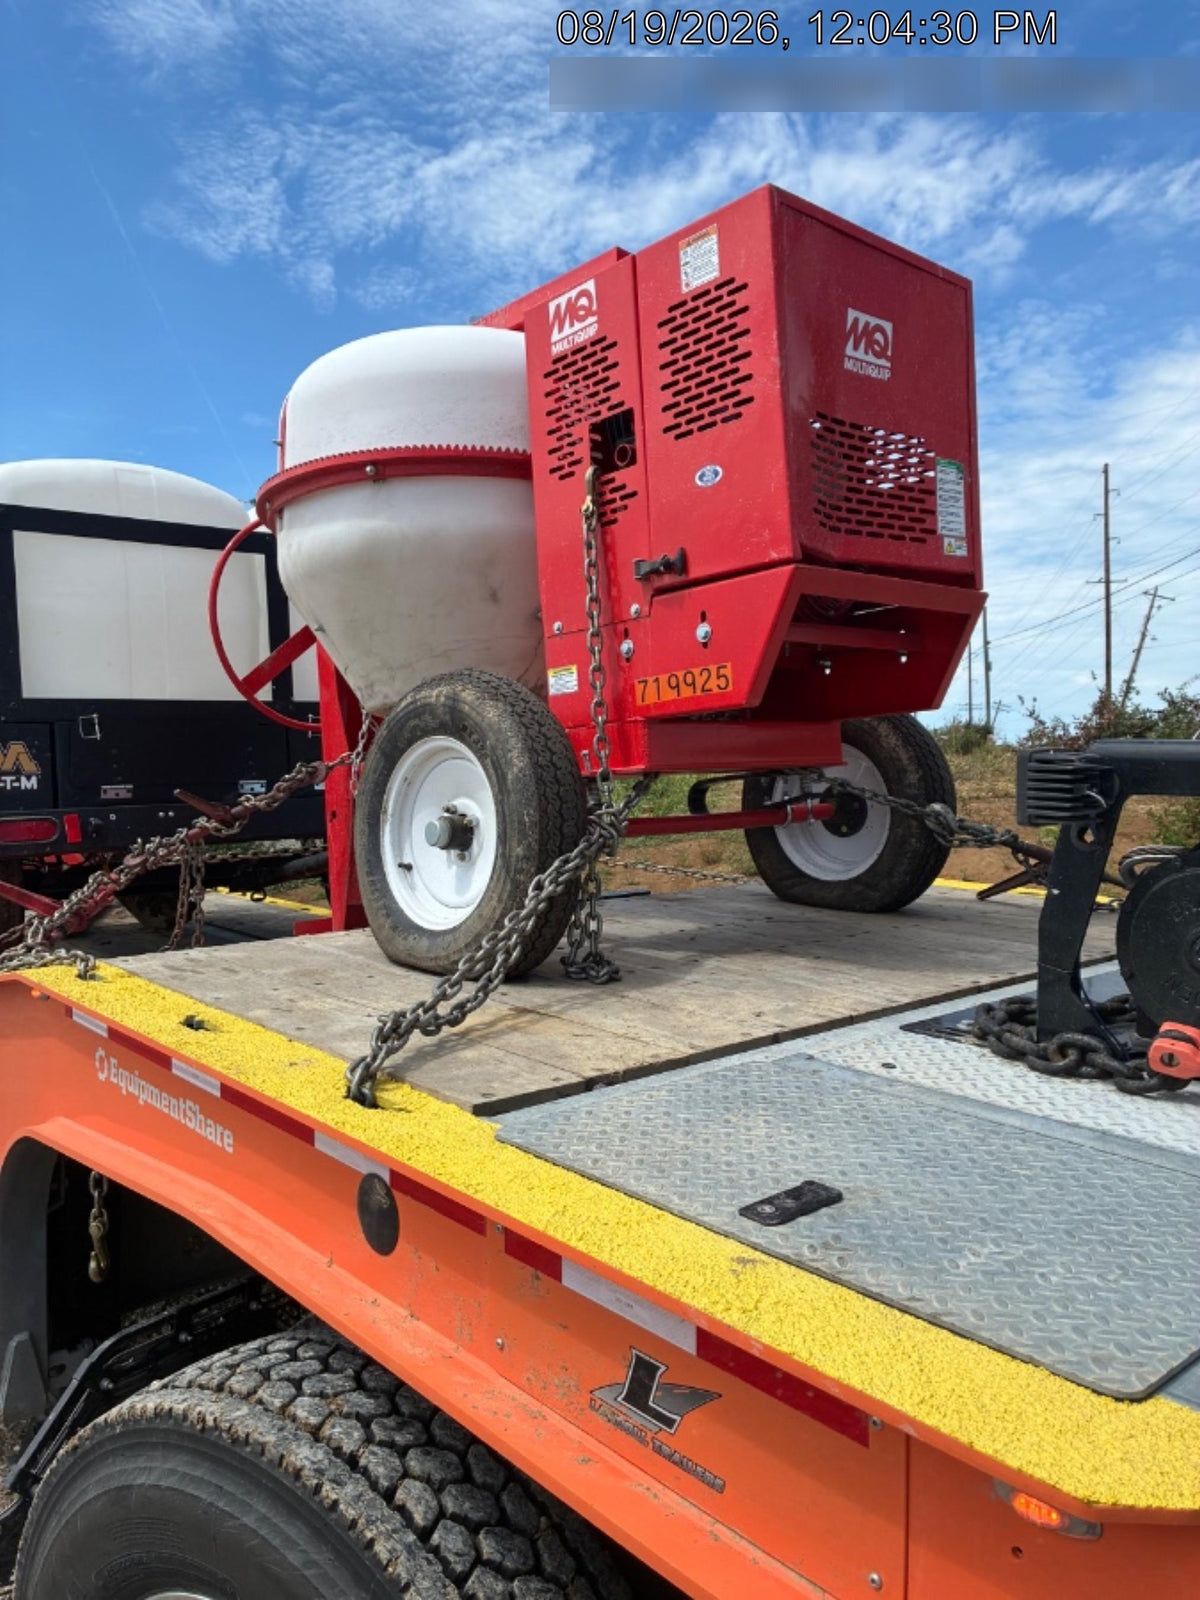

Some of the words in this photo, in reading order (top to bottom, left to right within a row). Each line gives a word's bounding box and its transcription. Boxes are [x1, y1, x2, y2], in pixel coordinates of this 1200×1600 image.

[547, 286, 598, 337] MQ
[551, 321, 599, 356] MULTIQUIP
[844, 315, 892, 361] MQ
[843, 355, 892, 382] MULTIQUIP
[637, 664, 731, 703] 719925
[109, 1055, 234, 1155] EquipmentShare
